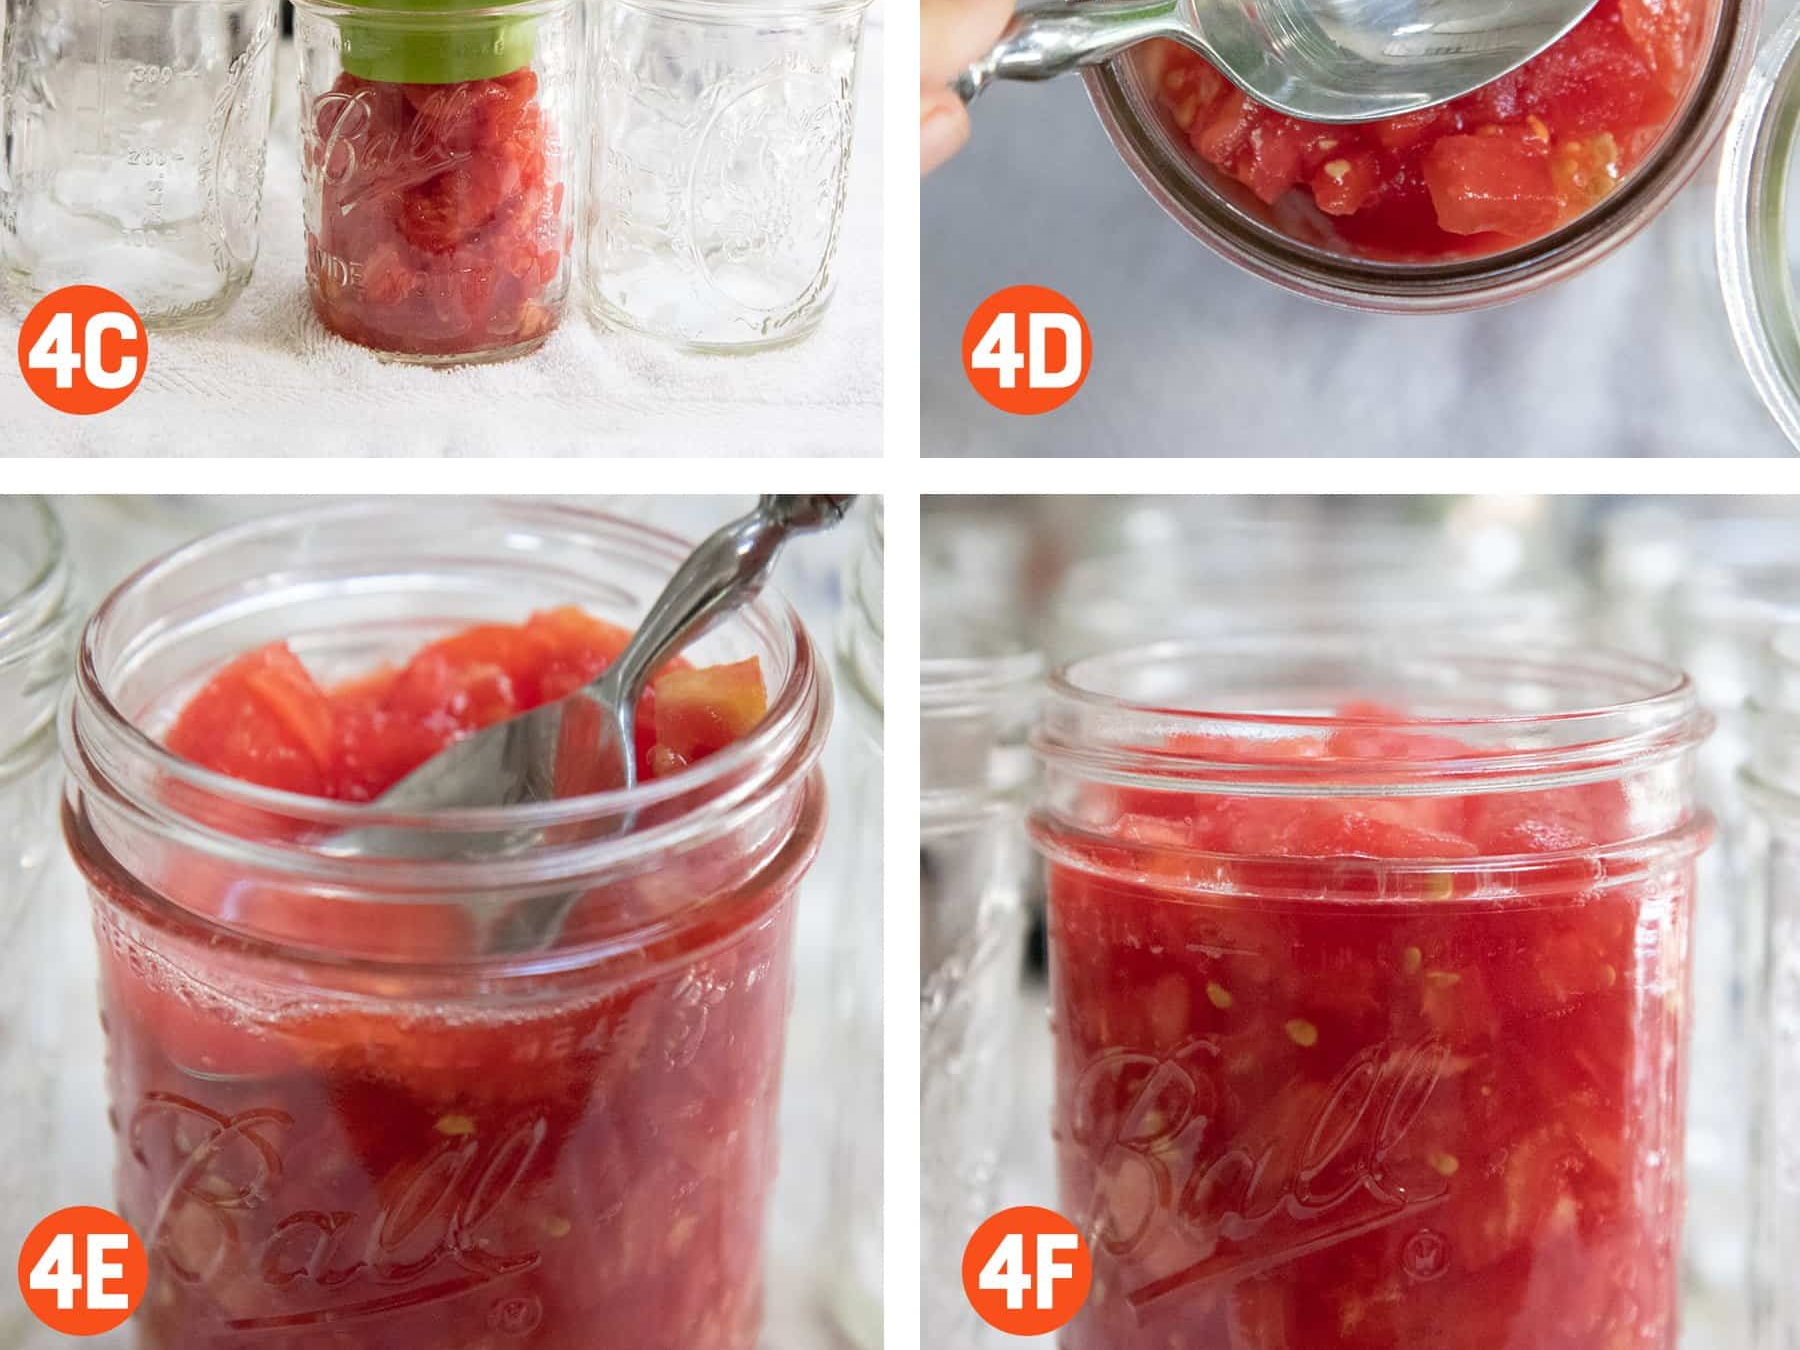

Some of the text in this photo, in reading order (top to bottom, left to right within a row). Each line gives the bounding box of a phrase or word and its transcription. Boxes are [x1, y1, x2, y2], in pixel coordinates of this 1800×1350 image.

[310, 82, 473, 190] Ball
[131, 1090, 546, 1287] Ball
[1072, 1034, 1451, 1257] Ball
